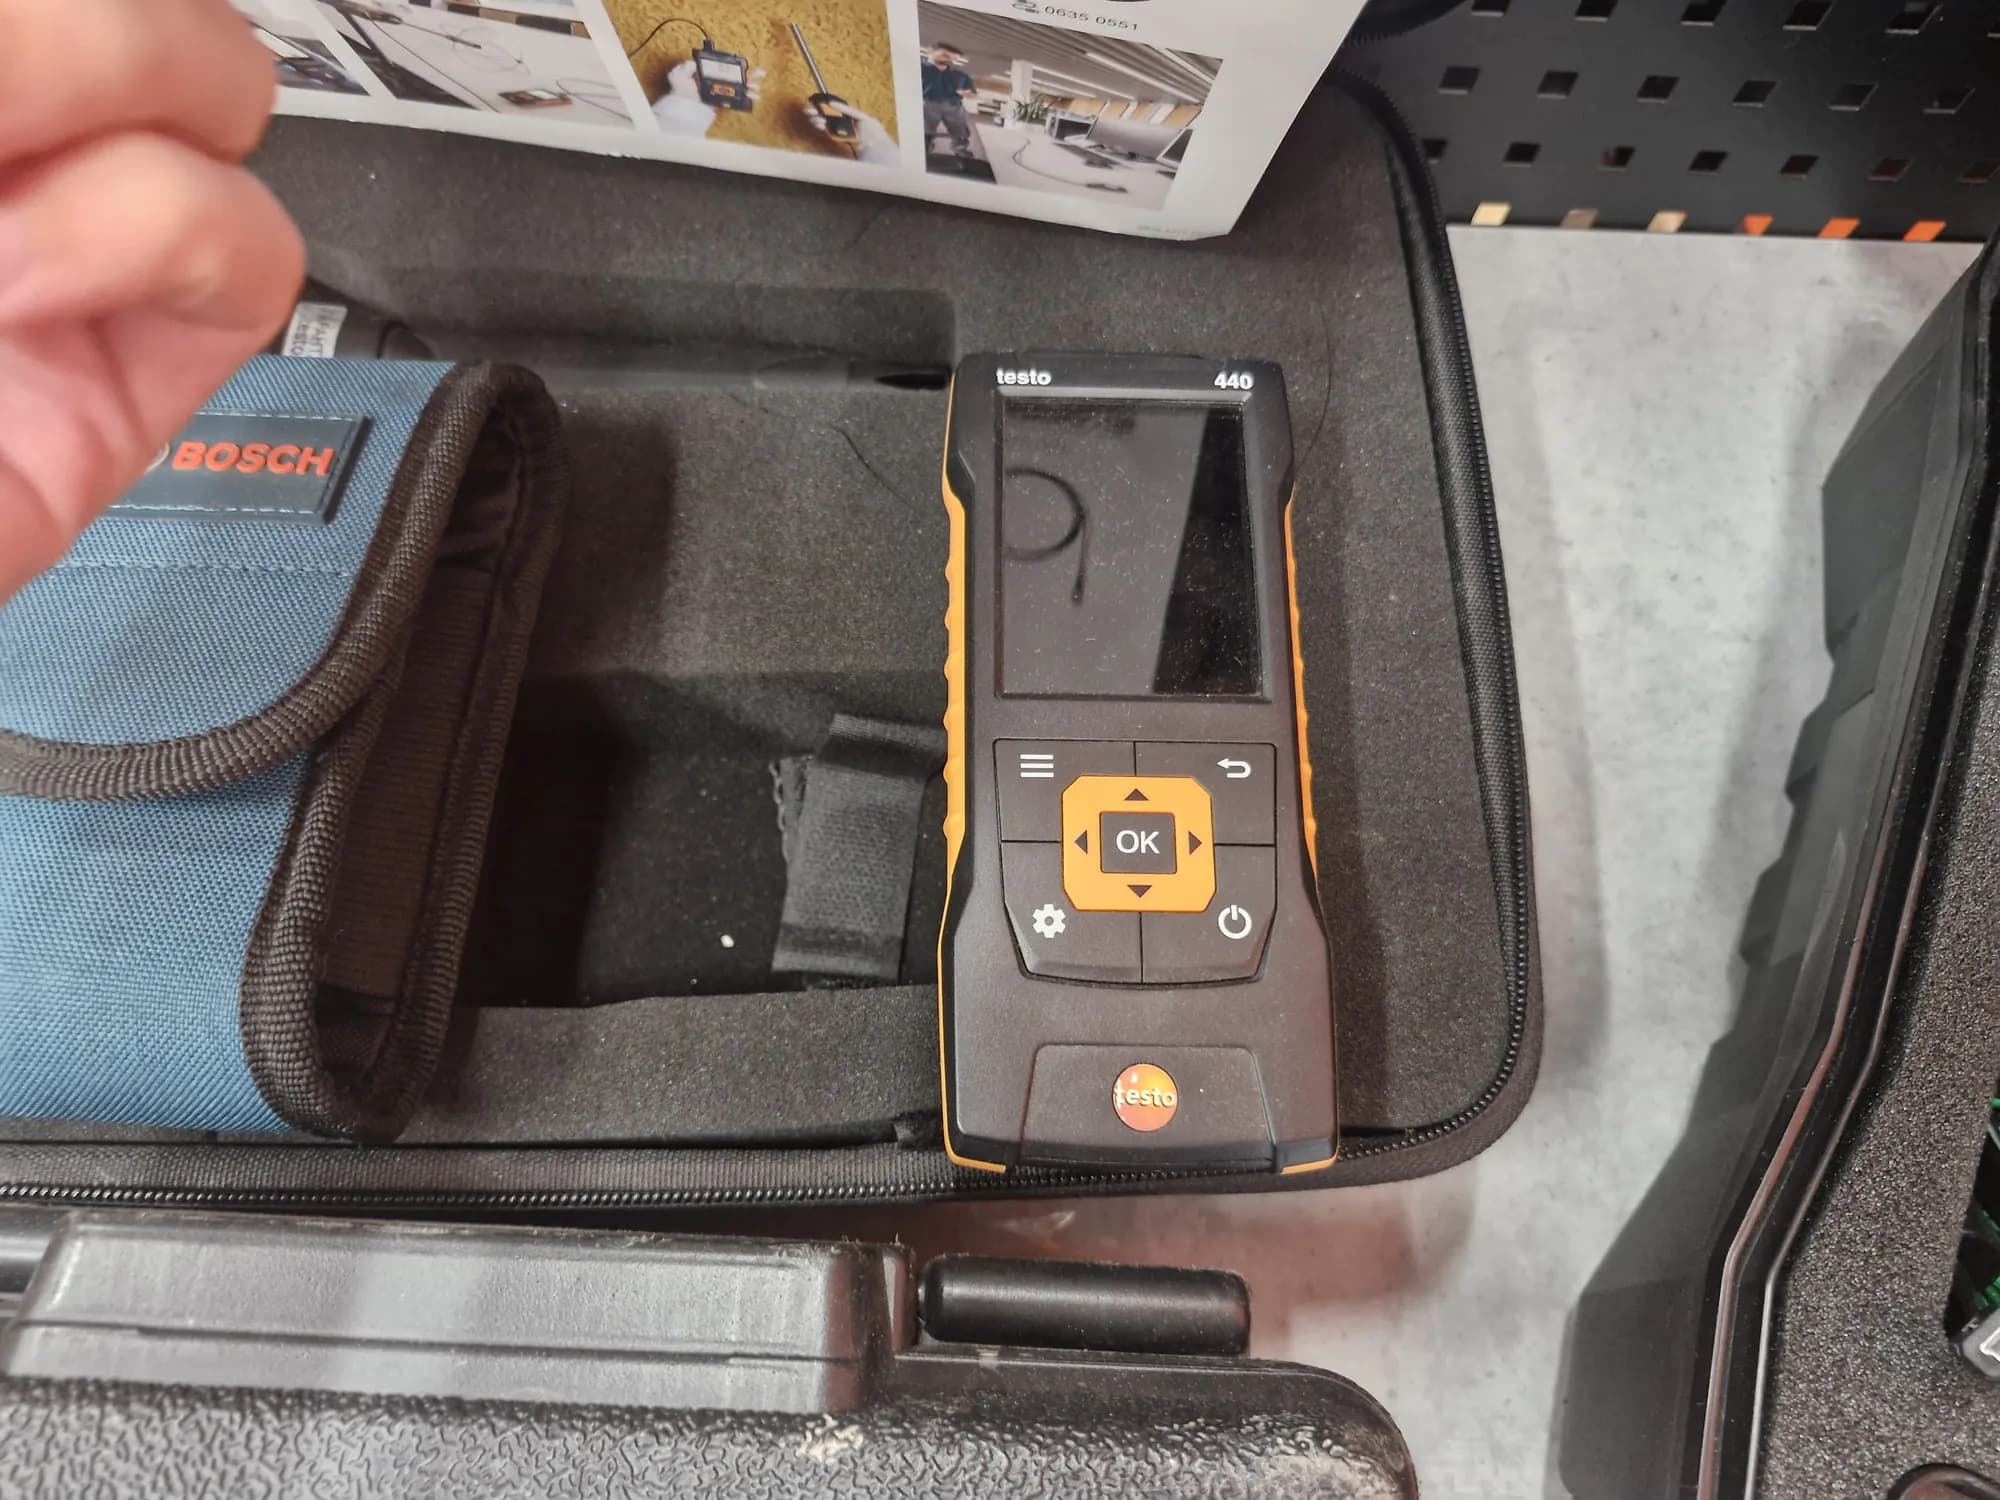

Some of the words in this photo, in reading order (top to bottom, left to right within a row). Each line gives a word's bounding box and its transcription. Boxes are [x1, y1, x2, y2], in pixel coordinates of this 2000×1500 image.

[1045, 6, 1089, 21] 0635
[1095, 16, 1138, 31] 0551
[996, 368, 1051, 386] testo
[1214, 372, 1254, 389] 440
[172, 441, 334, 476] BOSCH
[1116, 830, 1160, 854] OK
[1114, 1084, 1175, 1108] testo
